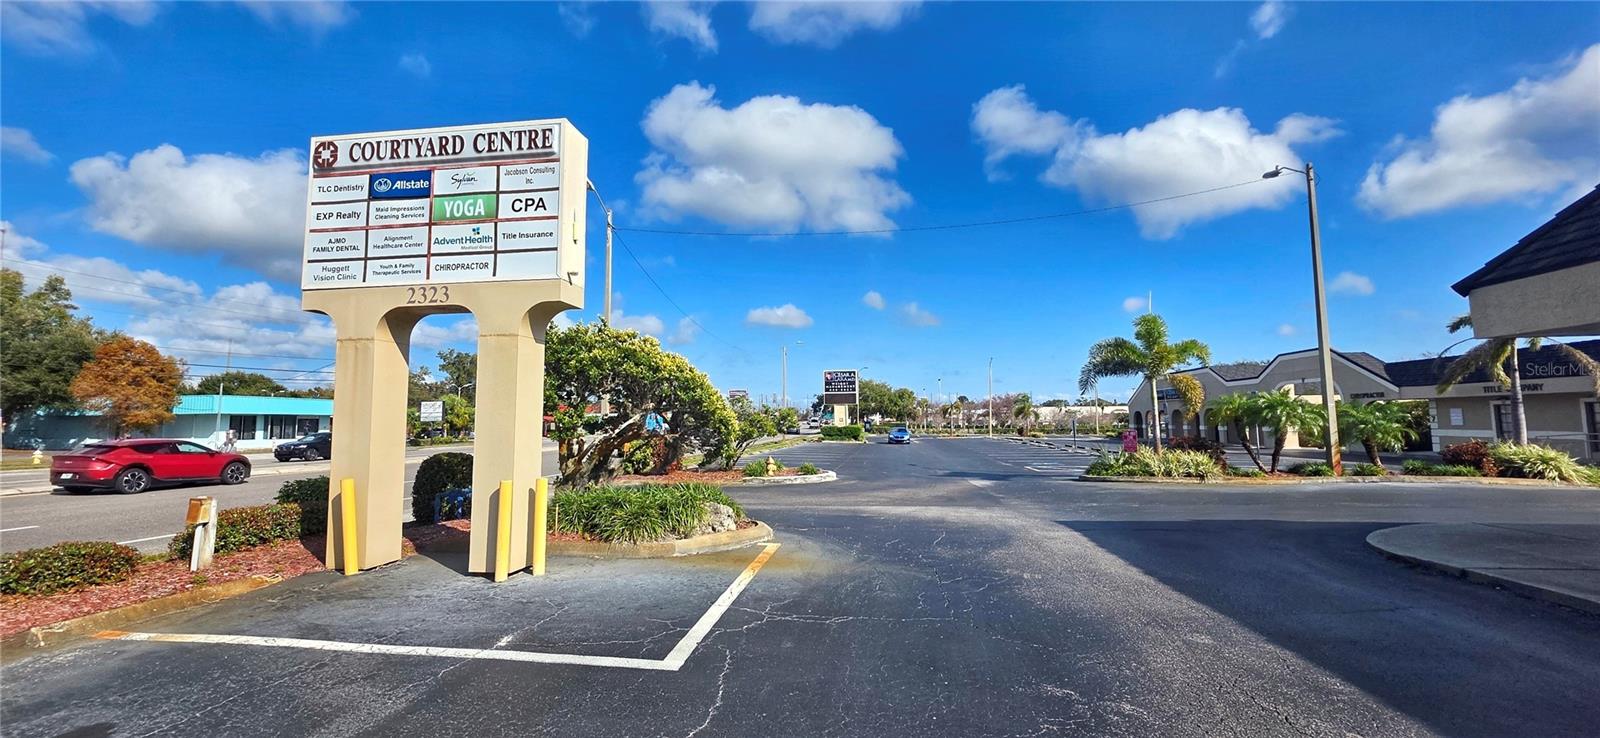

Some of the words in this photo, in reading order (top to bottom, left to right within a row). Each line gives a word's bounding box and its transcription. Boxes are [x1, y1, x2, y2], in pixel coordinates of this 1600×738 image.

[349, 135, 465, 162] COURTYARD
[473, 128, 554, 153] CENTRE
[504, 168, 529, 176] Jacobson
[529, 166, 556, 175] Consulting
[392, 179, 430, 190] Allstate
[451, 173, 478, 189] Sylvan
[525, 177, 534, 185] Inc.
[317, 185, 332, 193] TLC
[333, 183, 365, 192] Dentistry
[390, 205, 425, 213] Impressions
[444, 199, 485, 218] YOGA
[511, 197, 547, 213] CPA
[316, 212, 334, 221] EXP
[336, 210, 362, 220] Realty
[433, 235, 493, 245] AdventHealth
[501, 232, 517, 240] Title
[518, 231, 554, 239] Insurance
[328, 237, 347, 245] AJMO
[321, 265, 350, 273] Huggett
[434, 262, 489, 272] CHIROPRACTOR
[313, 274, 336, 282] Vision
[406, 285, 450, 305] 2323
[1483, 385, 1502, 393] TITLE
